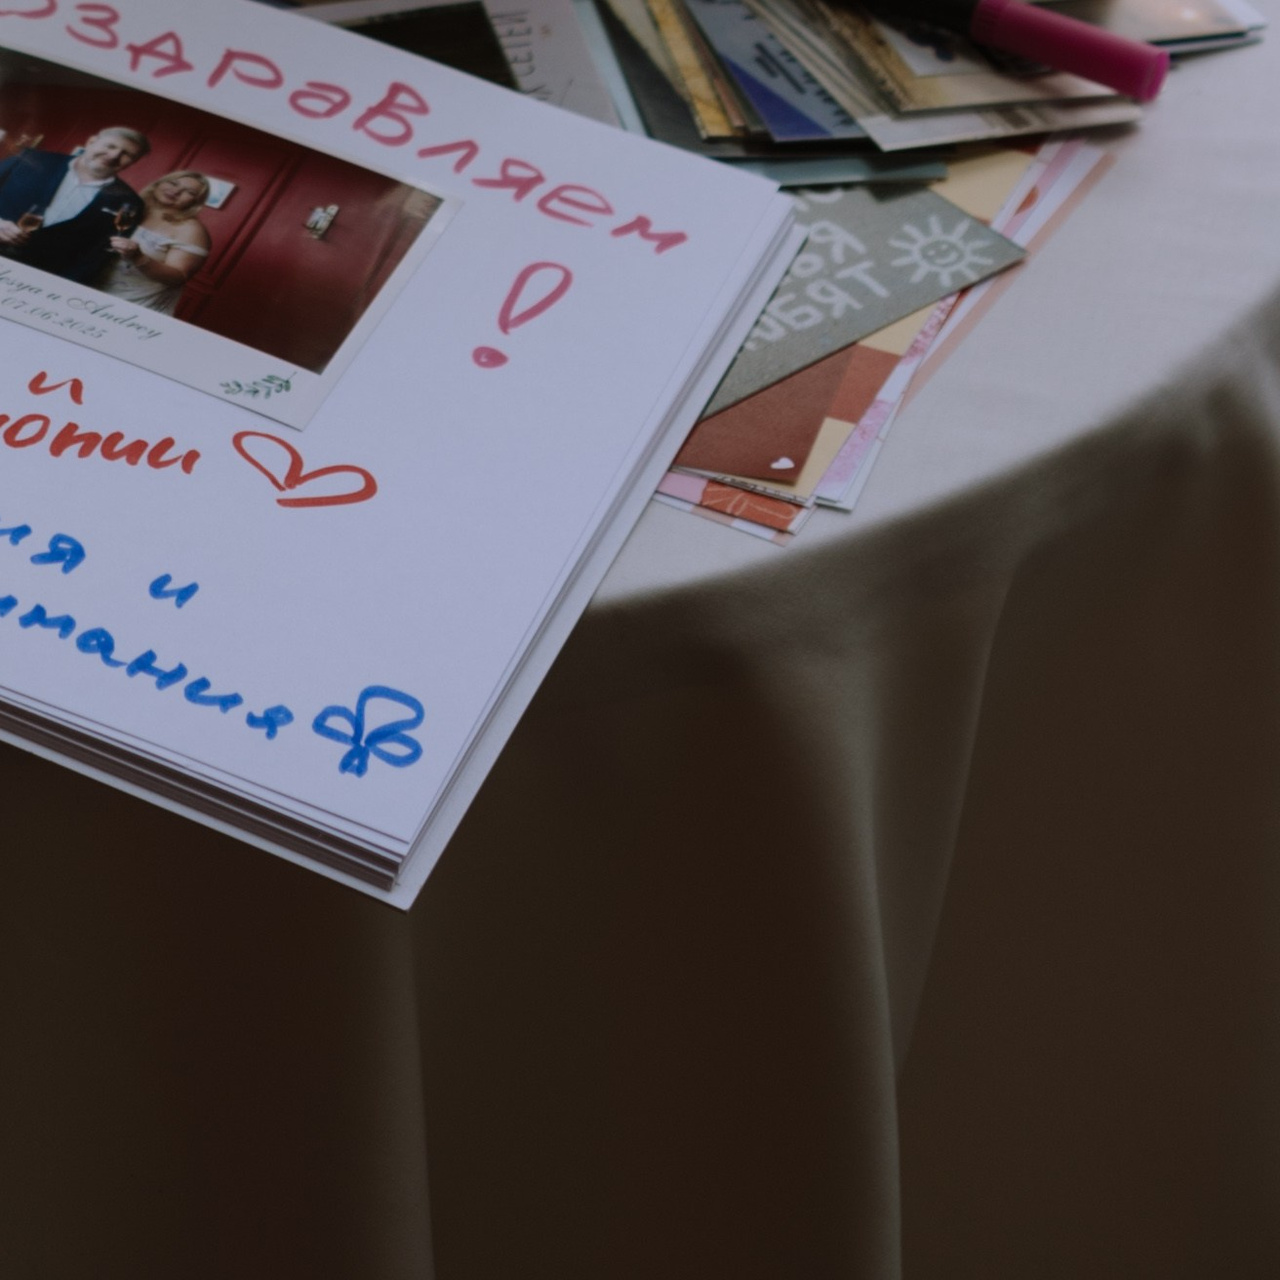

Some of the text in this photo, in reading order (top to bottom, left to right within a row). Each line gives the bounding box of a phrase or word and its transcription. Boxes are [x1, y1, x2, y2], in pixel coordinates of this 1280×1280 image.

[0, 295, 109, 340] 07.06.2025
[66, 297, 163, 341] Andrey
[28, 371, 83, 405] и
[148, 573, 200, 609] и
